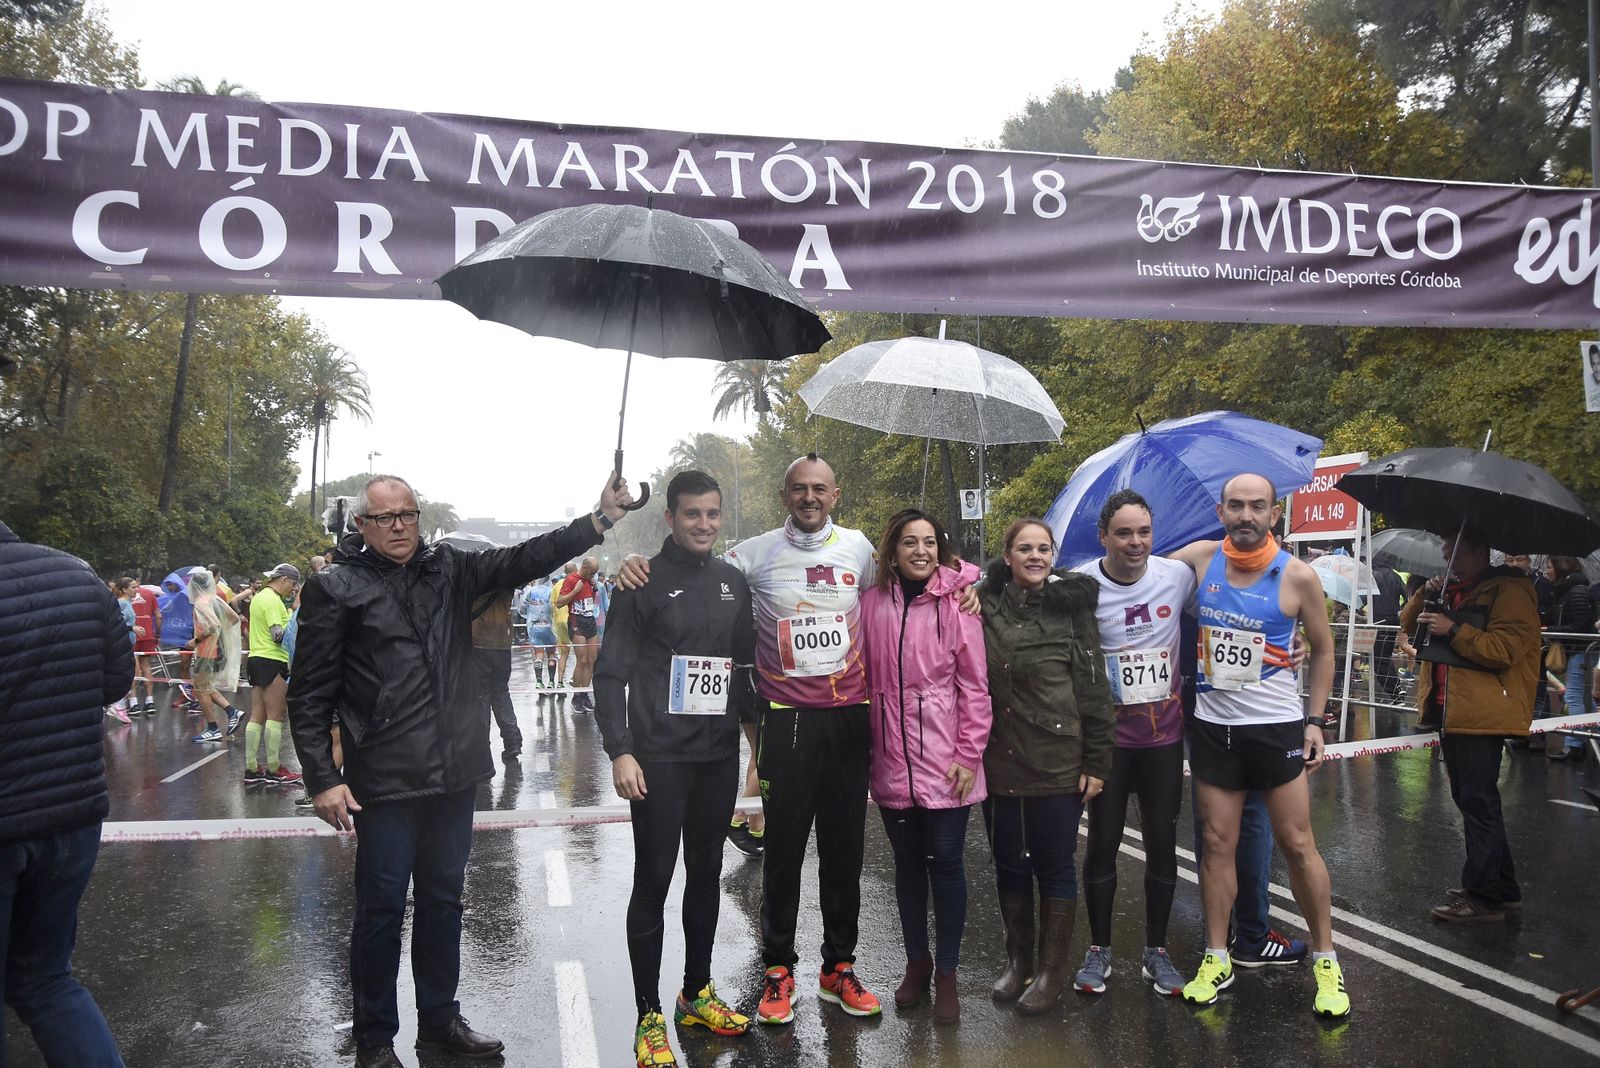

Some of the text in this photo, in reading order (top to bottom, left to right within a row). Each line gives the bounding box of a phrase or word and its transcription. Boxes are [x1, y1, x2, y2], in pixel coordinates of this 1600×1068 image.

[131, 108, 430, 182] MEDIA
[466, 133, 872, 210] MARATÓN
[907, 161, 1067, 219] 2018
[1217, 194, 1463, 261] IMDECO
[1136, 259, 1462, 288] Instituto Municipal de Deportes Córdoba
[1304, 502, 1344, 522] 1 AL 149
[1199, 605, 1264, 630] enerplus
[794, 630, 842, 651] 0000
[1214, 643, 1252, 667] 659
[688, 673, 729, 695] 7881
[1122, 662, 1169, 687] 8714
